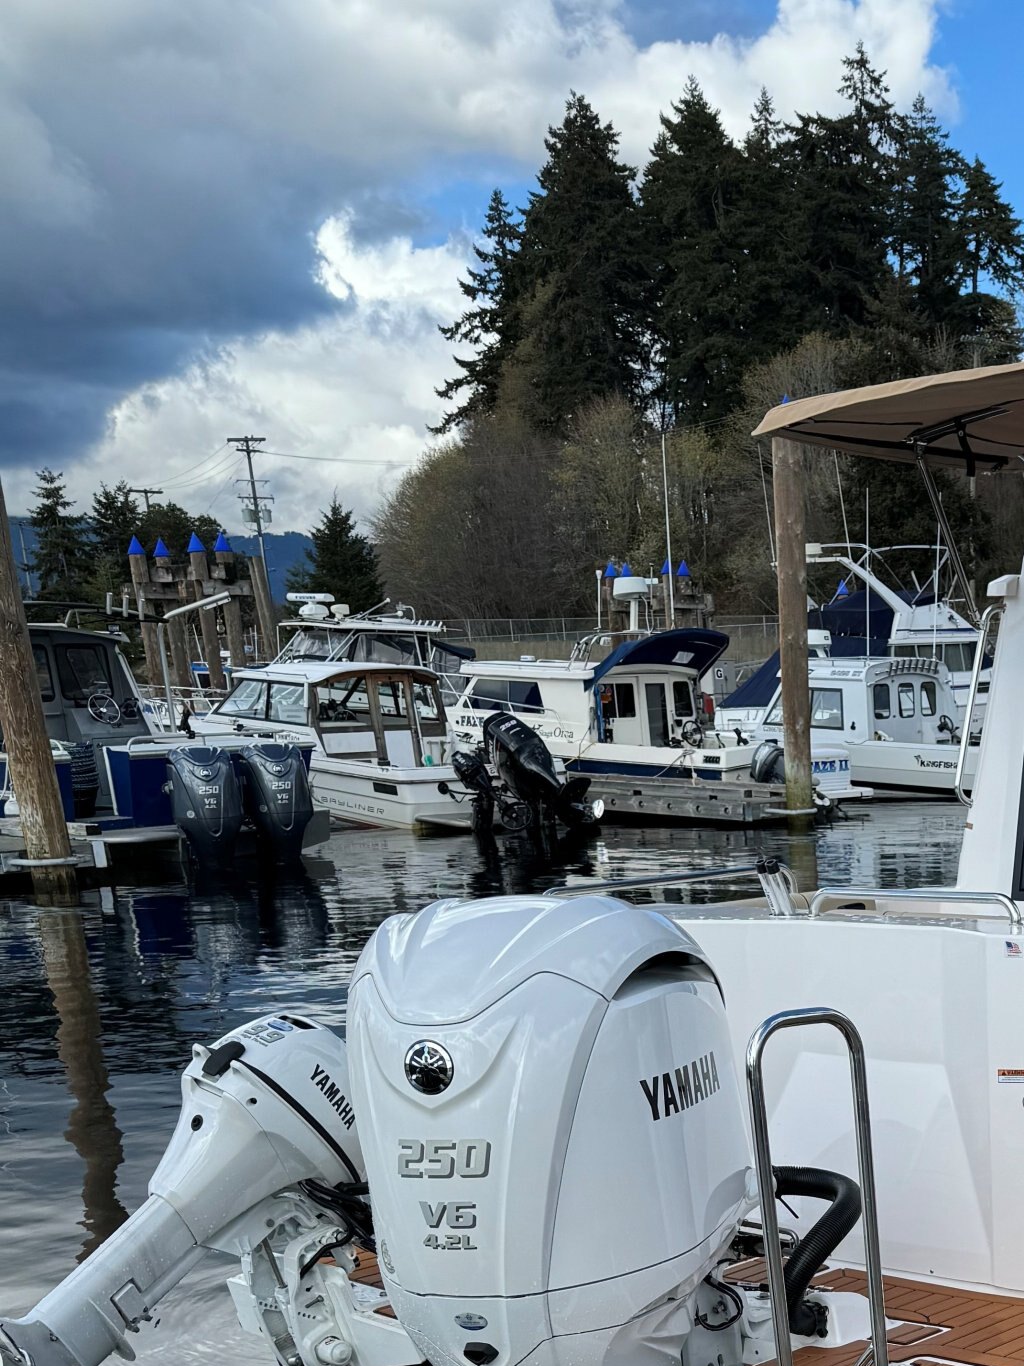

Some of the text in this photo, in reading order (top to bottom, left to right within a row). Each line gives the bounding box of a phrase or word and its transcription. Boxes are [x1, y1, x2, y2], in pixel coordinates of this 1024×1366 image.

[716, 669, 723, 678] G
[199, 785, 219, 795] 250
[271, 781, 291, 790] 250
[320, 796, 385, 815] BAYLINER
[639, 1051, 721, 1121] YAMAHA
[310, 1063, 356, 1131] YAMAHA
[398, 1139, 492, 1179] 250
[418, 1200, 477, 1229] V6
[423, 1233, 478, 1251] 4.2L
